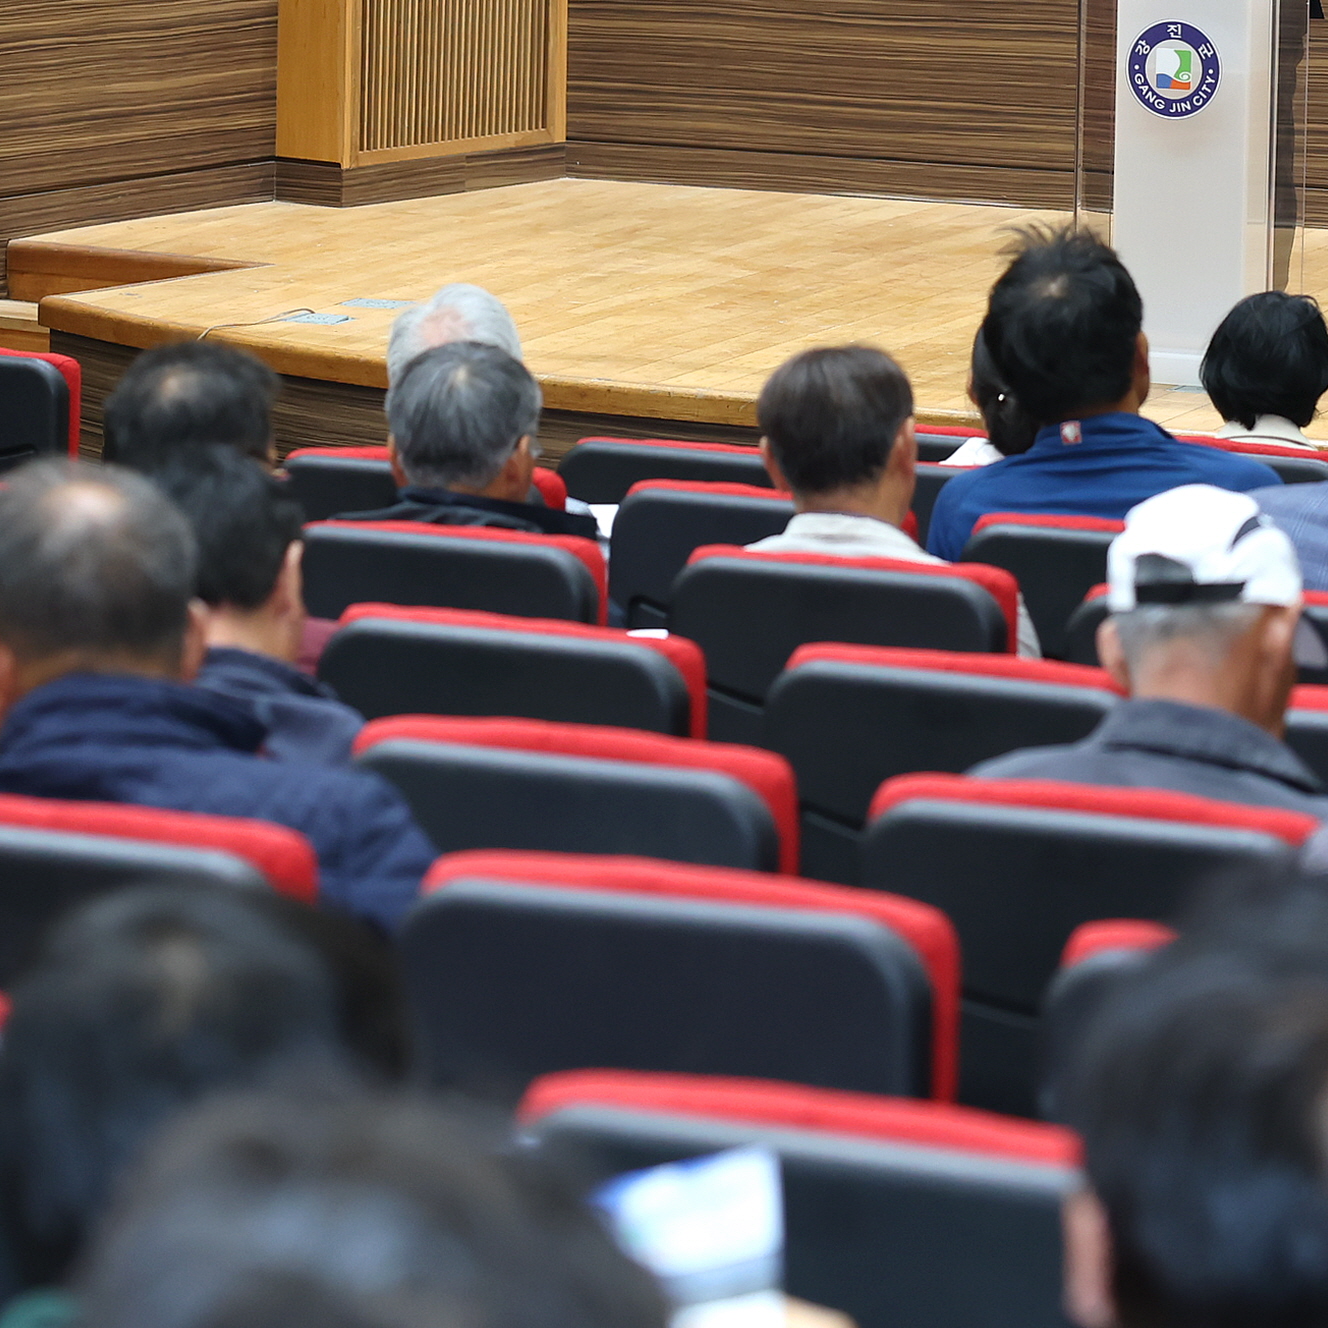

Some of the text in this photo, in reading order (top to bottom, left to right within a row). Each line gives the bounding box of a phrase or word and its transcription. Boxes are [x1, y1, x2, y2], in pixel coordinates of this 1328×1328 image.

[1134, 73, 1215, 112] GANG JIN CITY
